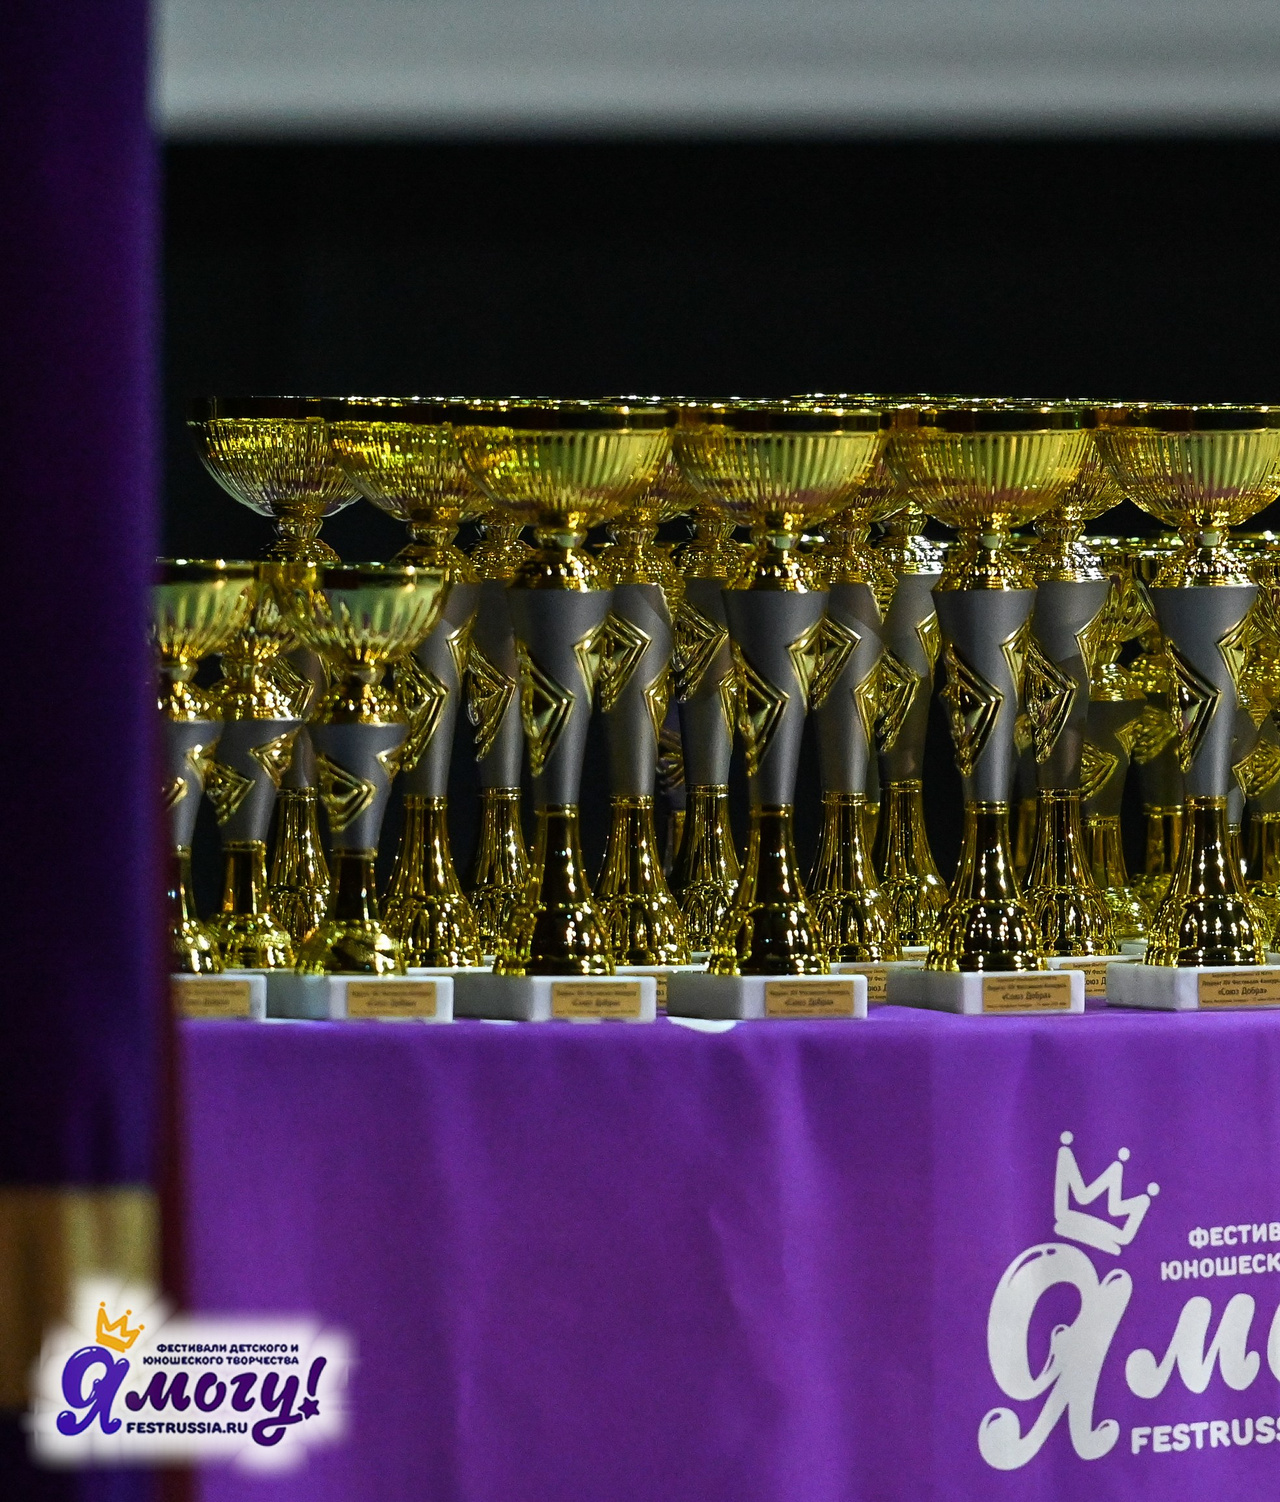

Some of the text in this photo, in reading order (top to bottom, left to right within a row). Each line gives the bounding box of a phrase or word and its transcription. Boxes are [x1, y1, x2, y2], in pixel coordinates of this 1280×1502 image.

[1218, 986, 1267, 996] «Союз Добра»
[978, 1242, 1133, 1470] Я
